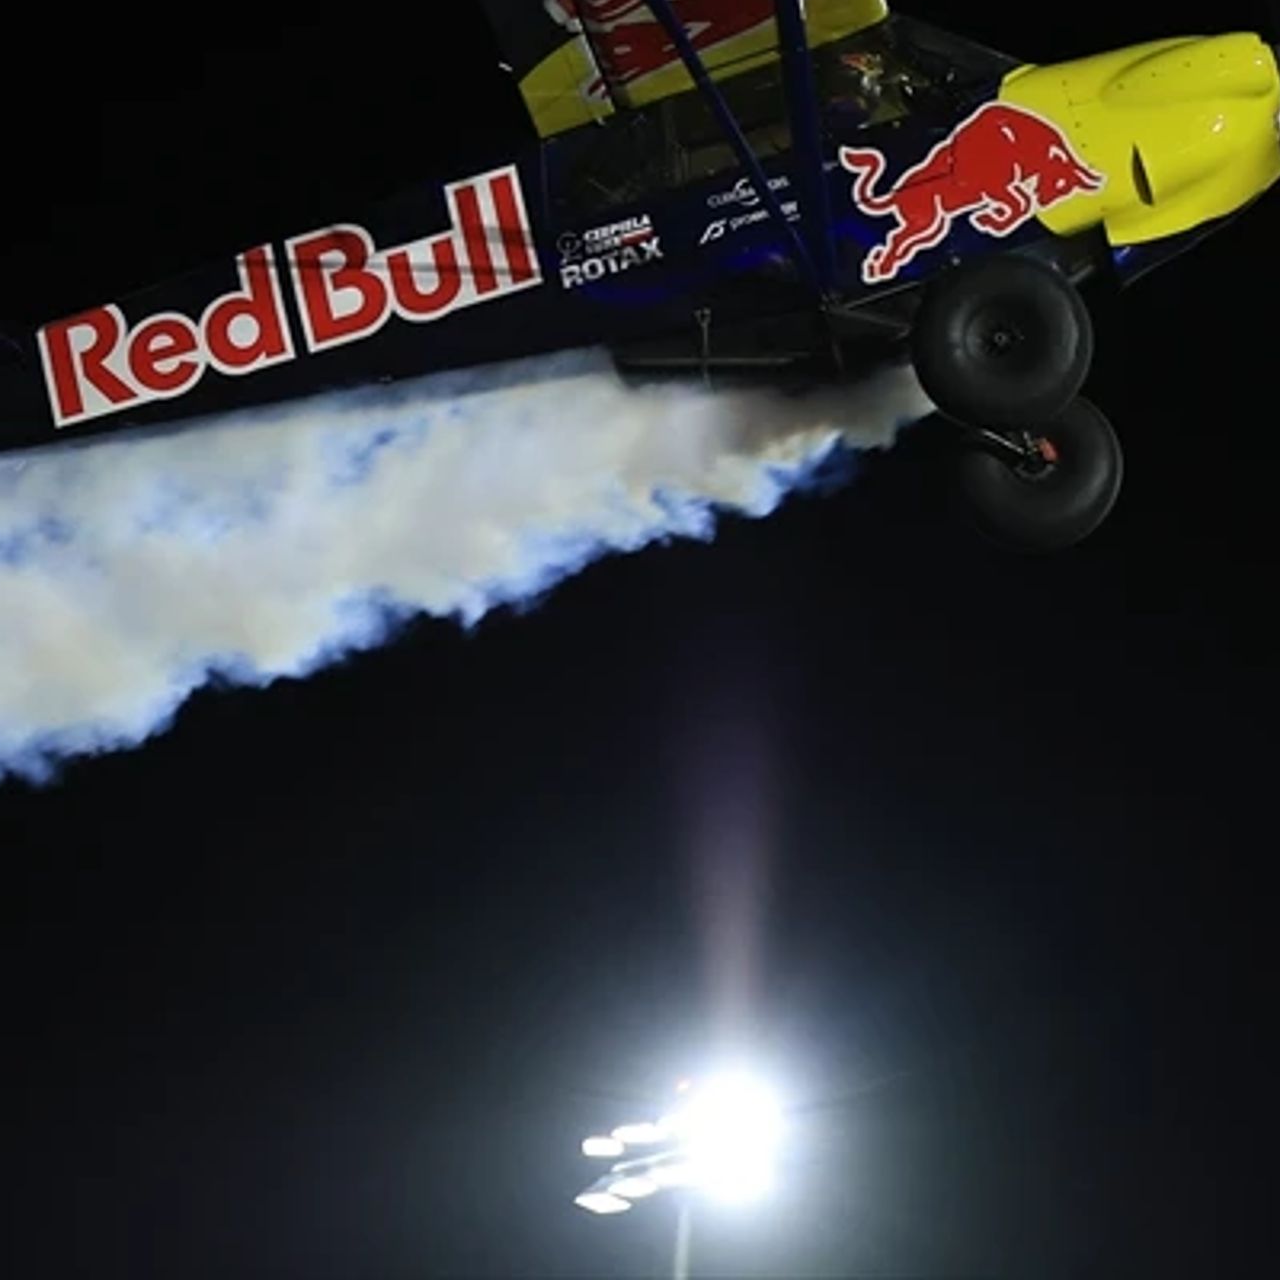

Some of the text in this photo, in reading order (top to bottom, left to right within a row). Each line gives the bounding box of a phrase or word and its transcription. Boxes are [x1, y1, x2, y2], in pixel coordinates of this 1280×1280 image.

[37, 164, 542, 428] Red Bull
[559, 235, 664, 289] ROTAX
